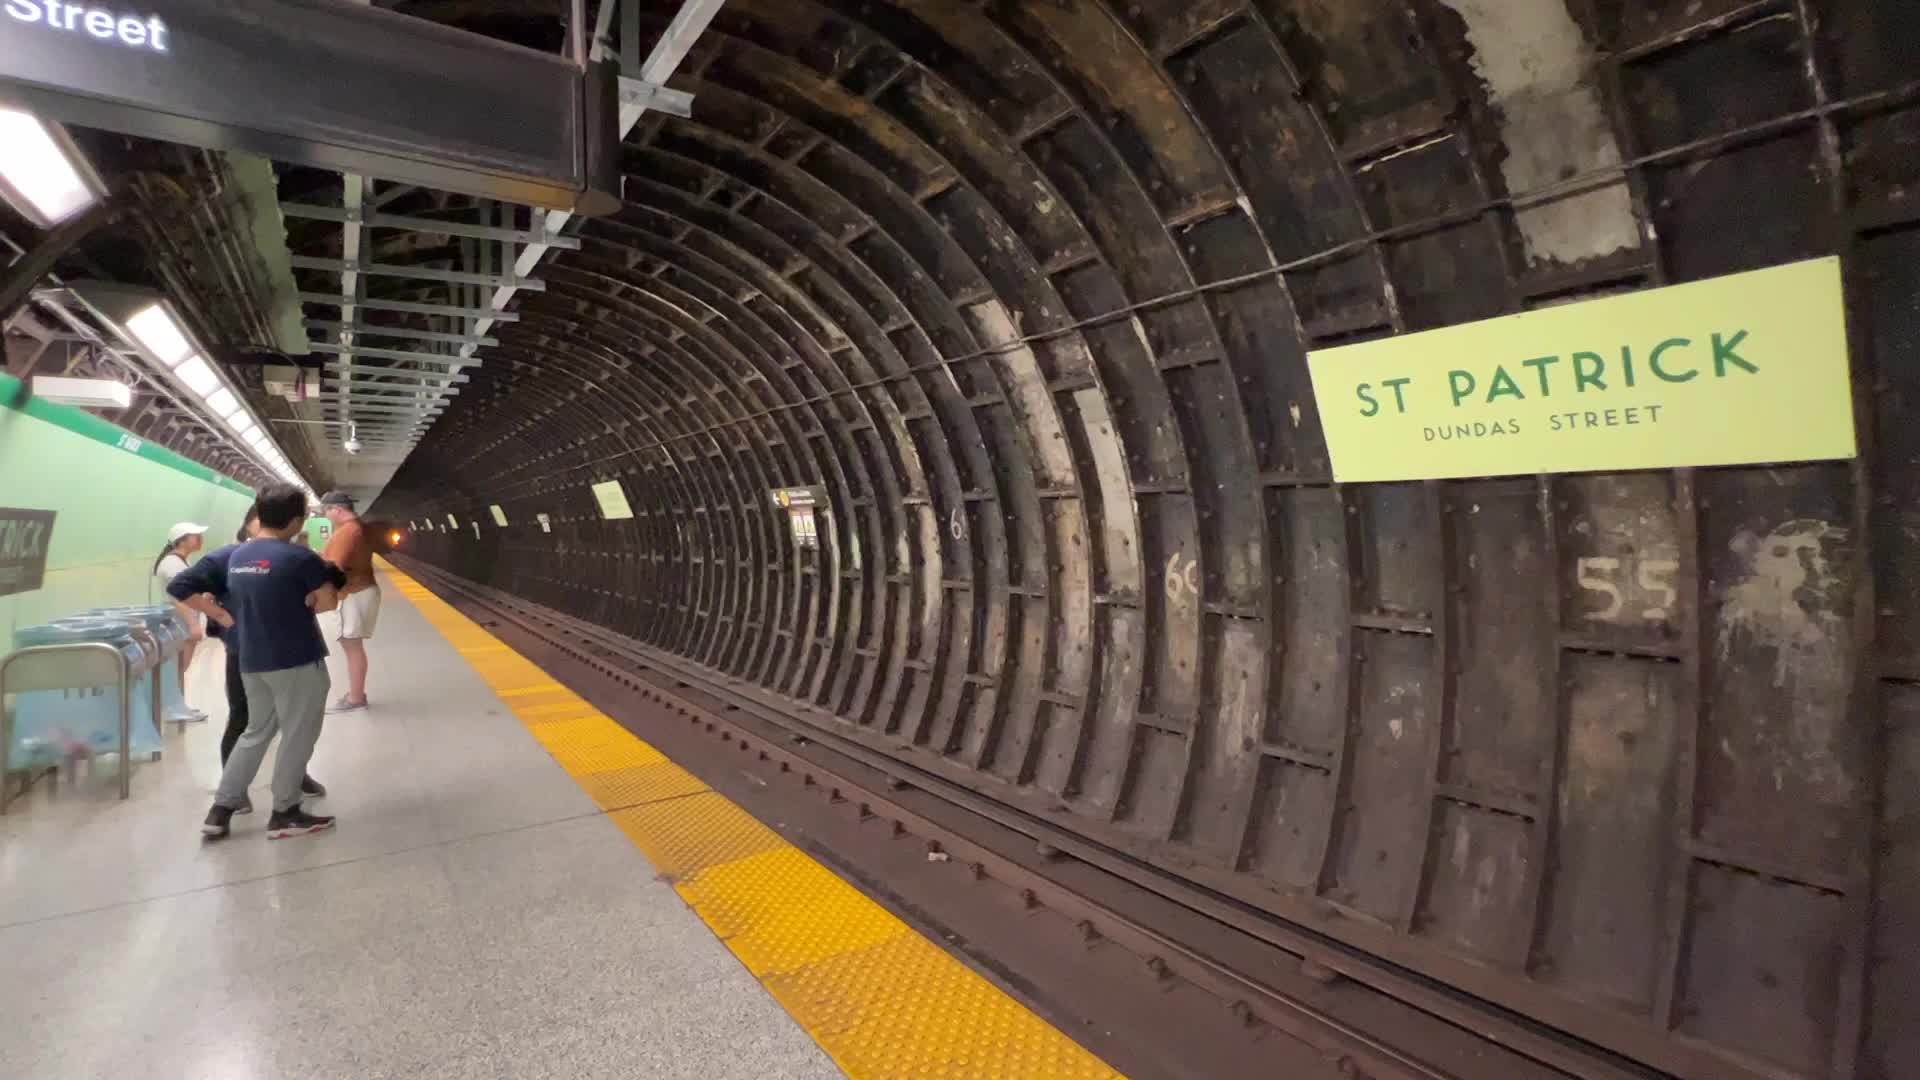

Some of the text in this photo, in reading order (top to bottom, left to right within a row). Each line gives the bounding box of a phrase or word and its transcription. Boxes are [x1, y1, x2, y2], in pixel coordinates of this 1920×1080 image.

[4, 0, 169, 51] Street
[1356, 329, 1760, 417] ST PATRICK
[1423, 405, 1663, 442] DUNDAS STREET
